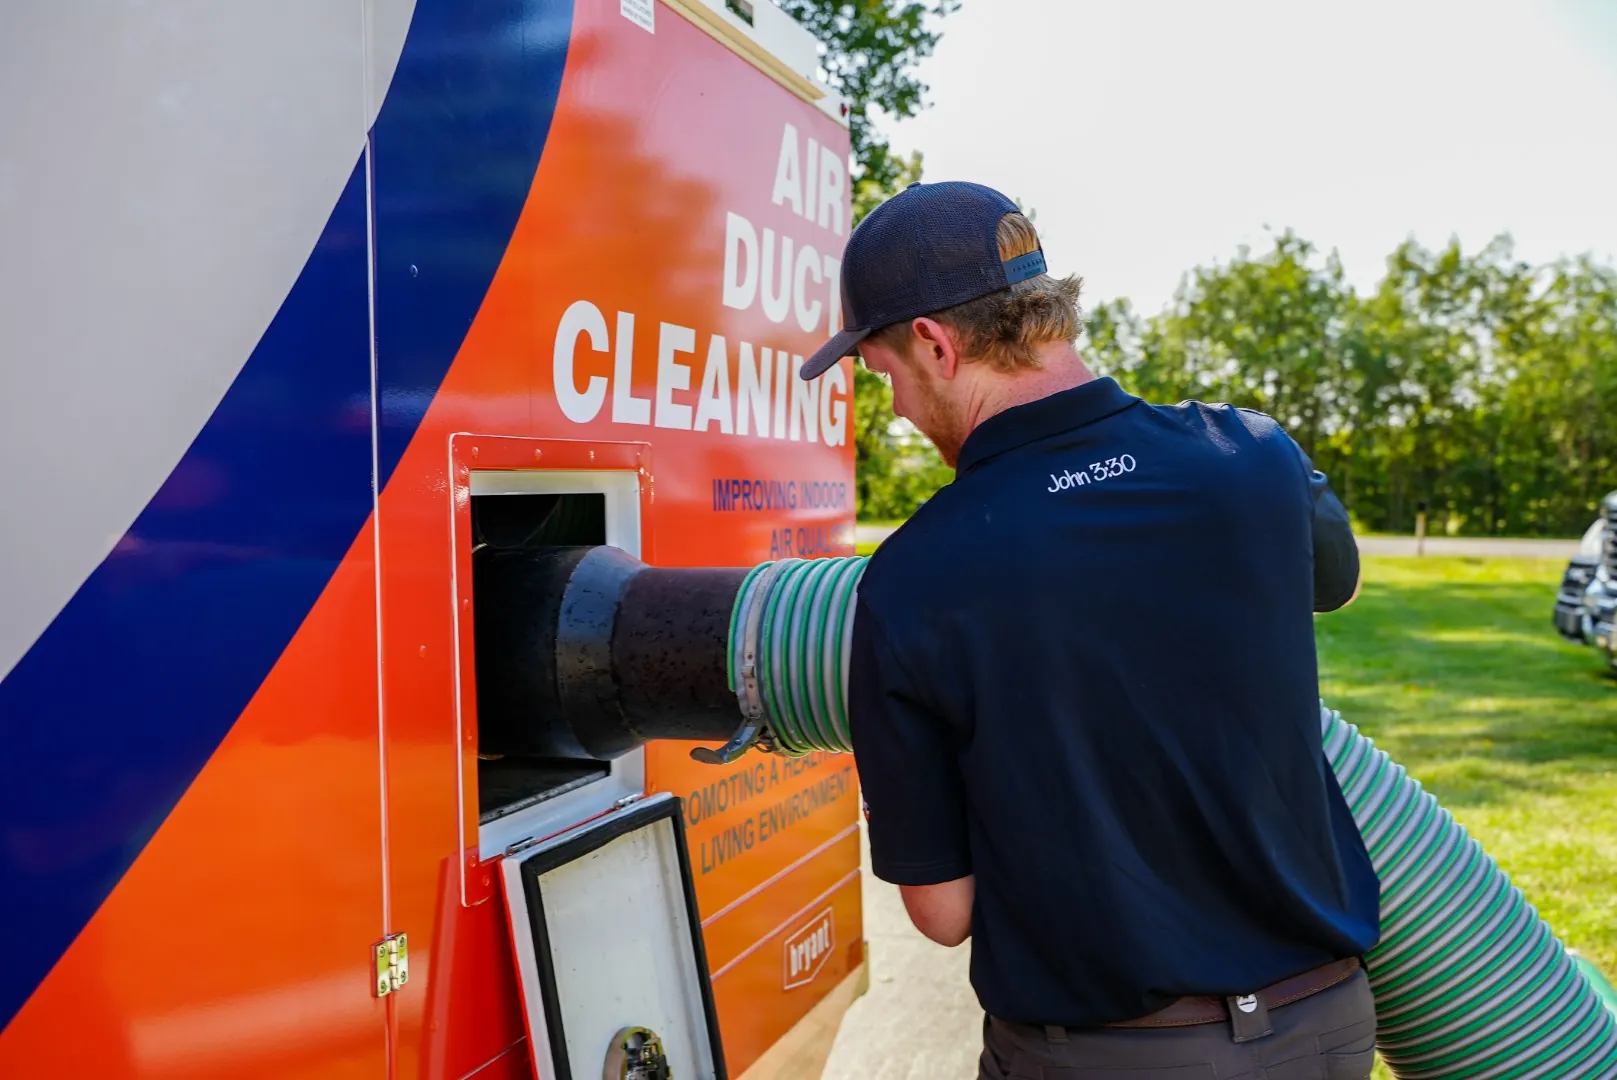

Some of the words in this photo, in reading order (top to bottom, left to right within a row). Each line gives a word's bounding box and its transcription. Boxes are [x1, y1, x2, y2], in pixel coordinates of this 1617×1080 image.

[771, 122, 844, 236] AIR
[722, 211, 843, 339] DUCT
[553, 300, 847, 448] CLEANING
[712, 478, 797, 512] IMPROVING
[801, 481, 847, 510] INDOOR
[1047, 469, 1092, 493] John
[1088, 453, 1137, 481] 3:30
[769, 527, 793, 559] AIR
[796, 524, 846, 557] QUAL
[680, 761, 765, 829] ROMOTING
[768, 756, 780, 789] A
[782, 751, 842, 782] HEAL
[701, 817, 755, 876] LIVING
[758, 765, 853, 842] ENVIRONMENT
[790, 918, 830, 977] bryant
